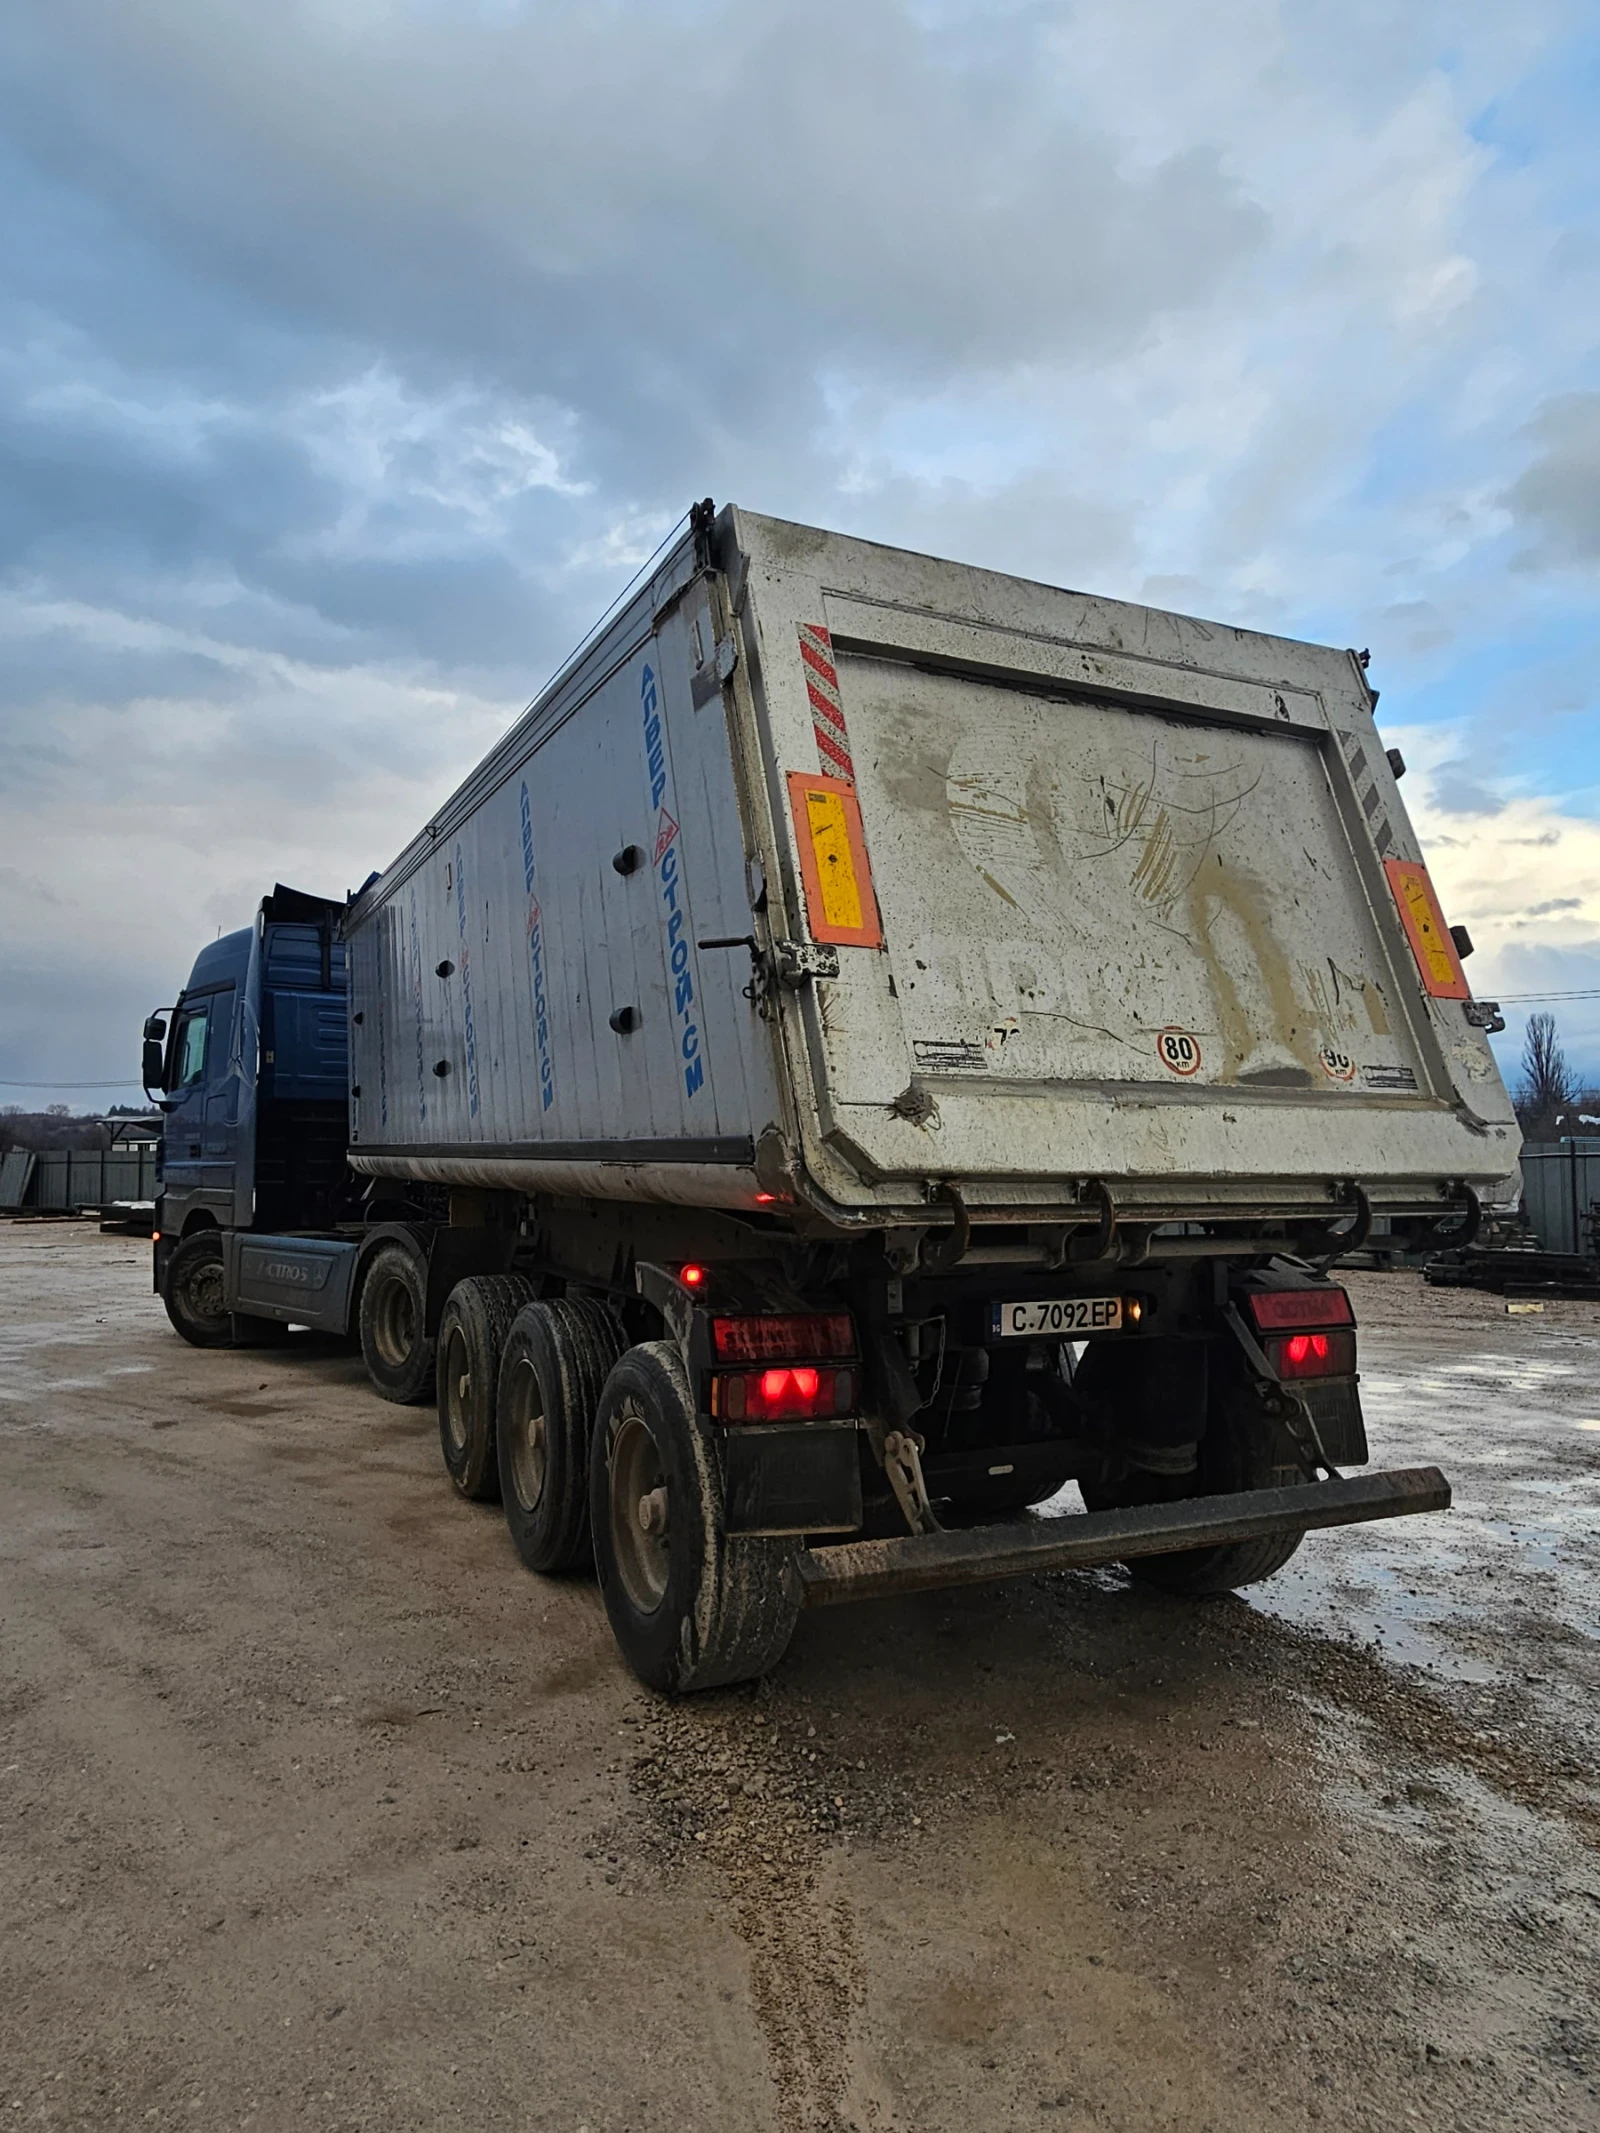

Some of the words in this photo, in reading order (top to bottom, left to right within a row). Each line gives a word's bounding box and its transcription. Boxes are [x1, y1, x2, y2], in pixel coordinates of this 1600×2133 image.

[641, 662, 666, 811] АЛВЕР
[660, 847, 704, 1099] СТРОЙ-СМ
[1164, 1036, 1193, 1061] 80
